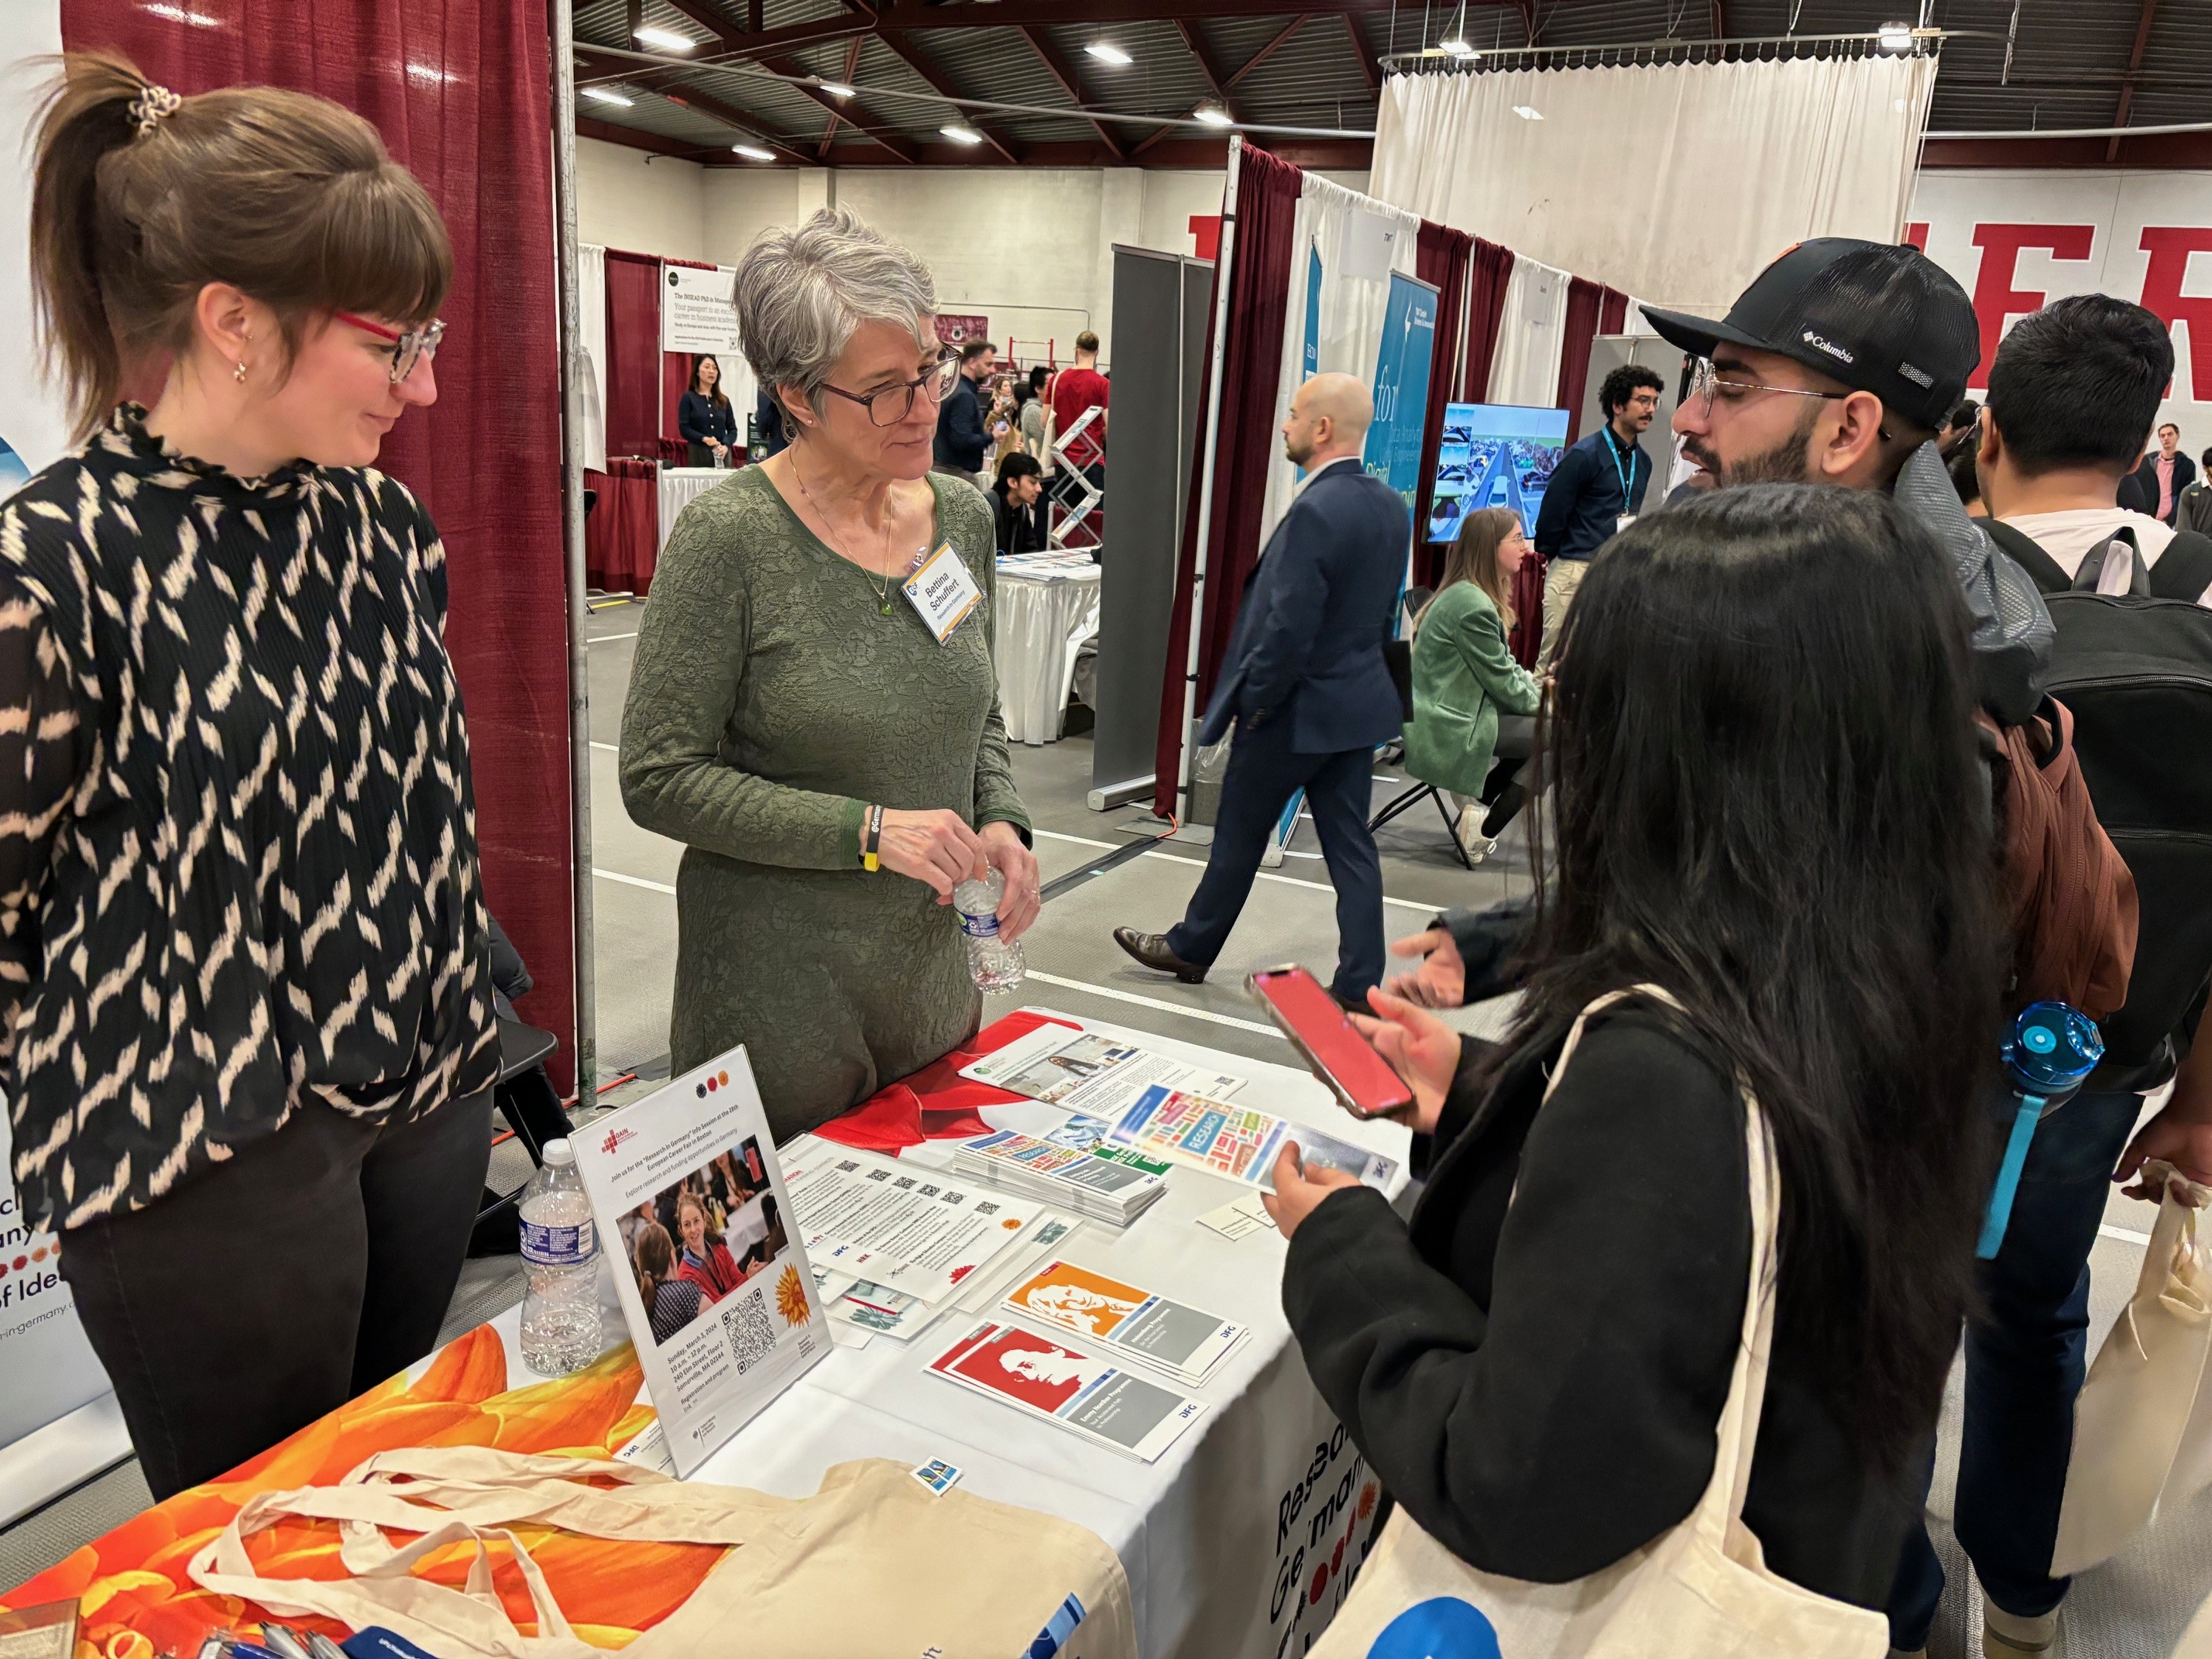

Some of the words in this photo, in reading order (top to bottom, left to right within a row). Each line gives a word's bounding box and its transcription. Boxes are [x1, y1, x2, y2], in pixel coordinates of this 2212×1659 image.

[687, 305, 707, 314] passport
[697, 314, 716, 322] business
[1812, 336, 1853, 363] Columbia
[1375, 364, 1399, 422] for
[925, 572, 950, 598] Bettina
[930, 579, 960, 611] Schuffert
[937, 603, 951, 620] Research
[952, 590, 966, 605] Germany
[611, 1173, 622, 1183] Join
[635, 1159, 644, 1168] the
[692, 1125, 701, 1135] Info
[701, 1117, 717, 1129] Session
[729, 1104, 739, 1113] 28th
[616, 1128, 629, 1139] GAIN
[625, 1184, 643, 1198] Explore
[643, 1172, 663, 1188] research
[662, 1166, 672, 1176] and
[671, 1157, 689, 1171] funding
[688, 1141, 716, 1161] opportunities
[719, 1127, 738, 1142] Germany
[647, 1156, 669, 1171] European
[668, 1146, 683, 1159] Career
[683, 1142, 692, 1151] Fair
[697, 1130, 713, 1142] Boston
[832, 1245, 849, 1257] DFG
[856, 1253, 871, 1263] HRK
[667, 1348, 687, 1364] Sunday,
[685, 1335, 701, 1350] March
[705, 1323, 717, 1335] 2024
[1220, 1325, 1236, 1338] DFG
[673, 1372, 684, 1382] 240
[682, 1365, 692, 1376] Elm
[692, 1354, 709, 1369] Street,
[707, 1345, 720, 1357] Floor
[678, 1358, 688, 1368] a.m.
[696, 1344, 707, 1355] p.m.
[676, 1370, 702, 1392] Somerville,
[701, 1362, 711, 1372] MA
[709, 1351, 724, 1365] 02144
[680, 1383, 706, 1405] Registration
[705, 1376, 713, 1385] and
[713, 1364, 730, 1380] program
[1080, 1408, 1097, 1422] Emmy
[1092, 1395, 1111, 1411] Noether
[1108, 1378, 1132, 1398] Programme
[1178, 1404, 1197, 1419] DFG
